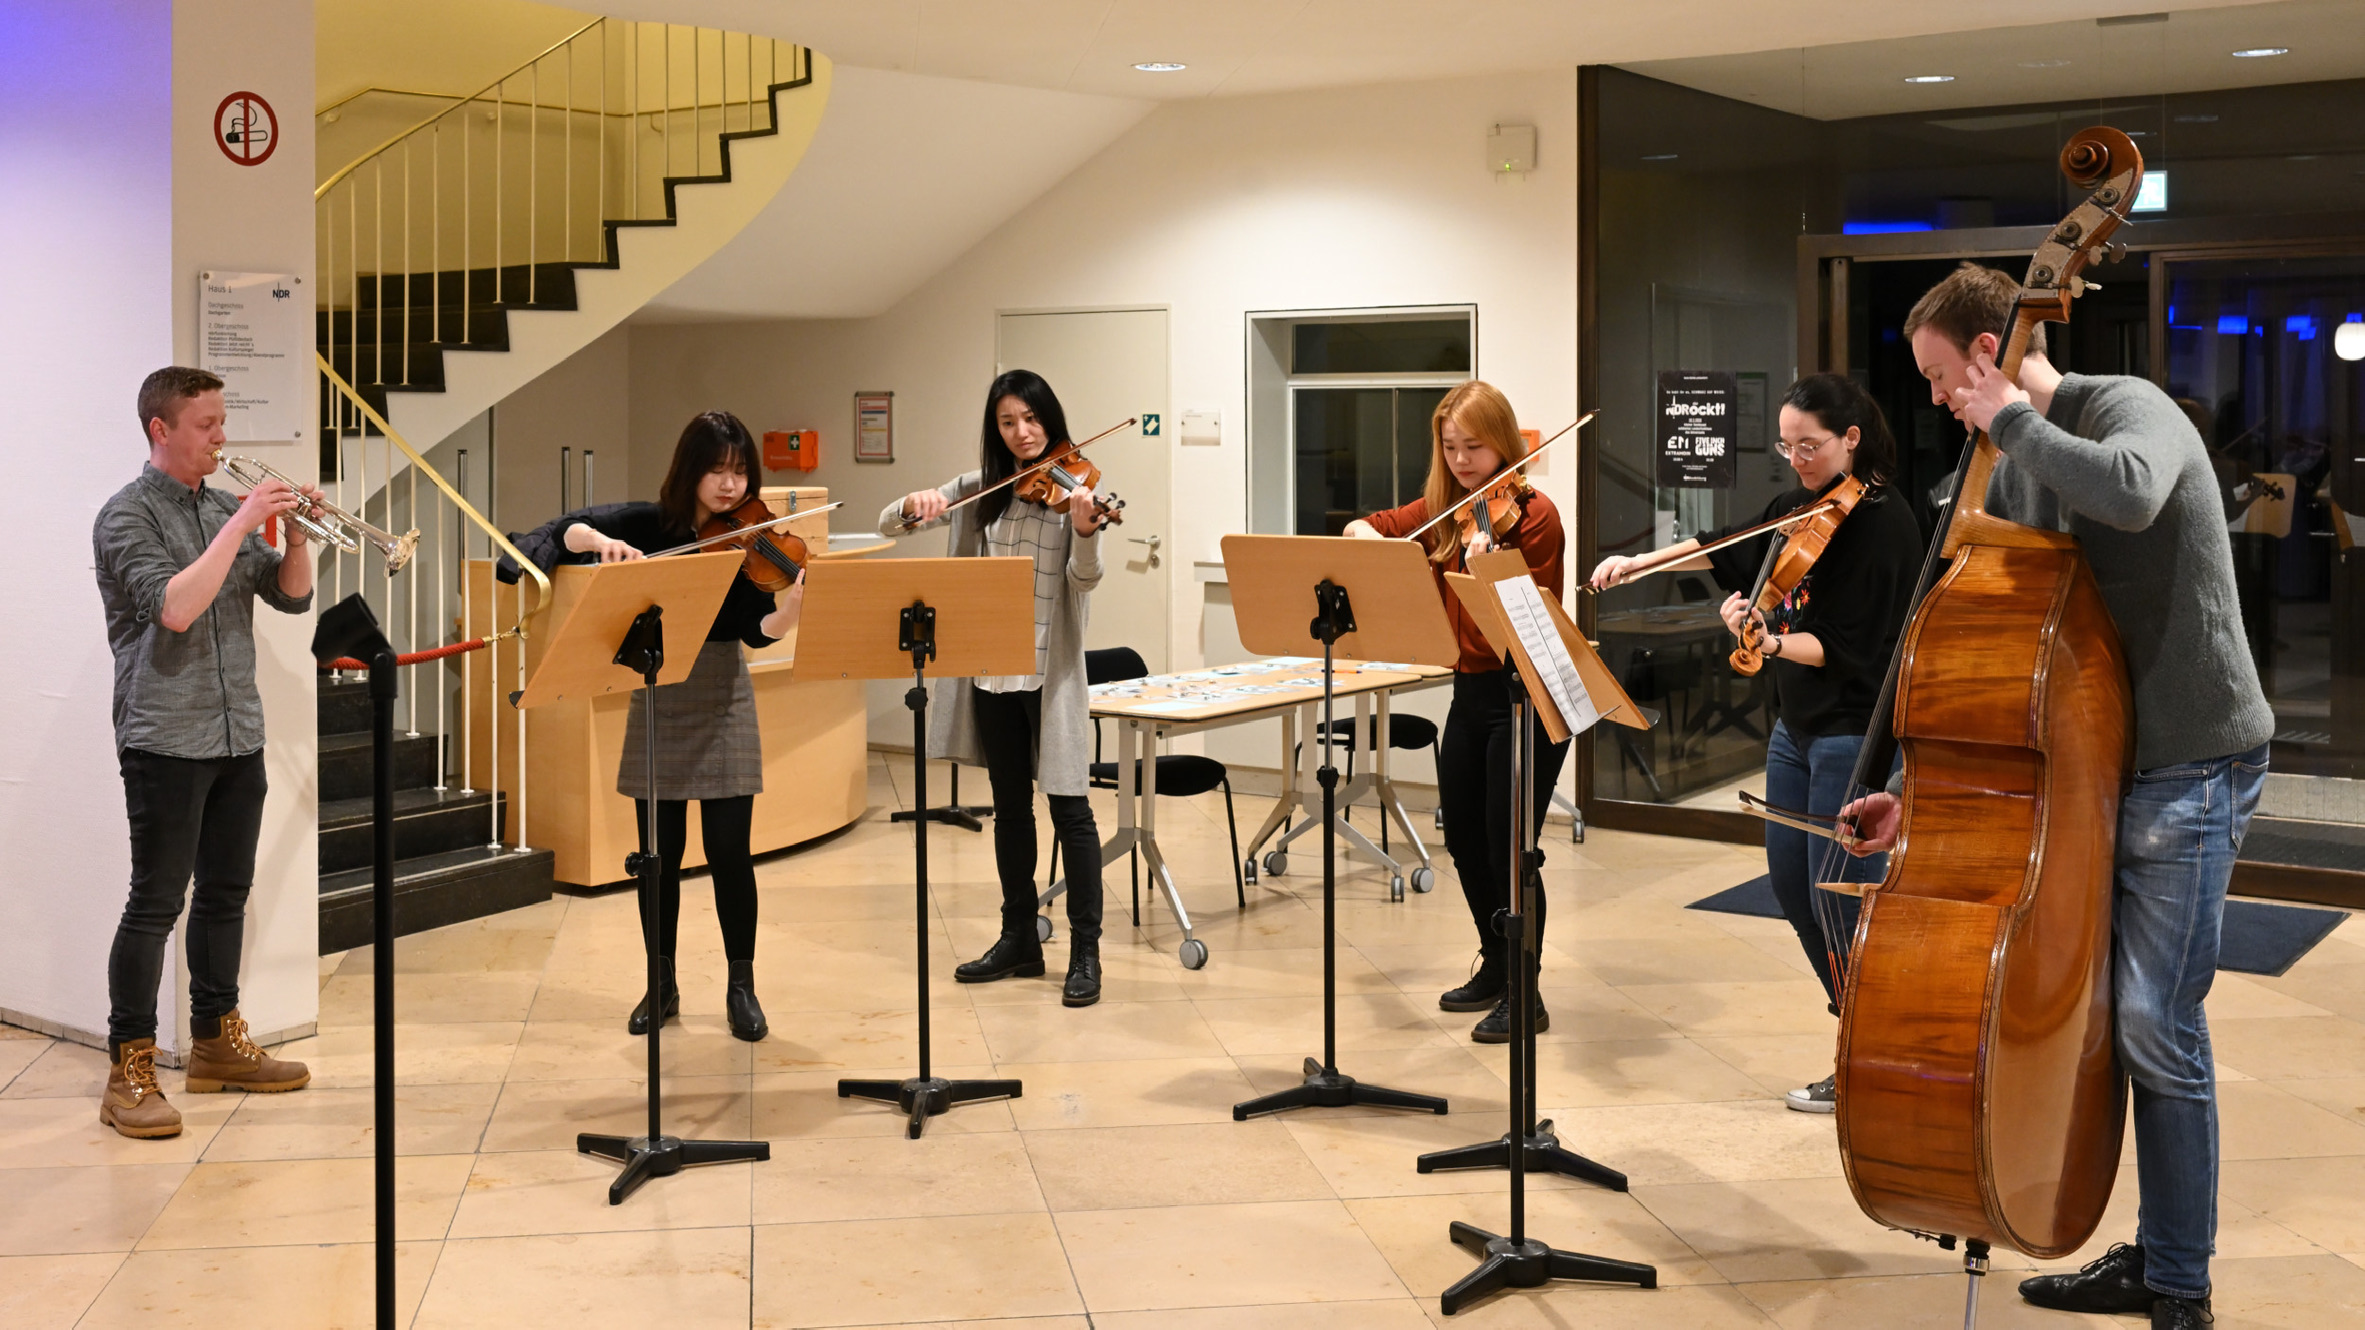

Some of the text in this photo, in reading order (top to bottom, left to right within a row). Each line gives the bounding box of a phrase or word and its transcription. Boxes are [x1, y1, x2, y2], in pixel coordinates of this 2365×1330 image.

[208, 284, 232, 294] Haus 1
[1695, 443, 1725, 456] GUNS
